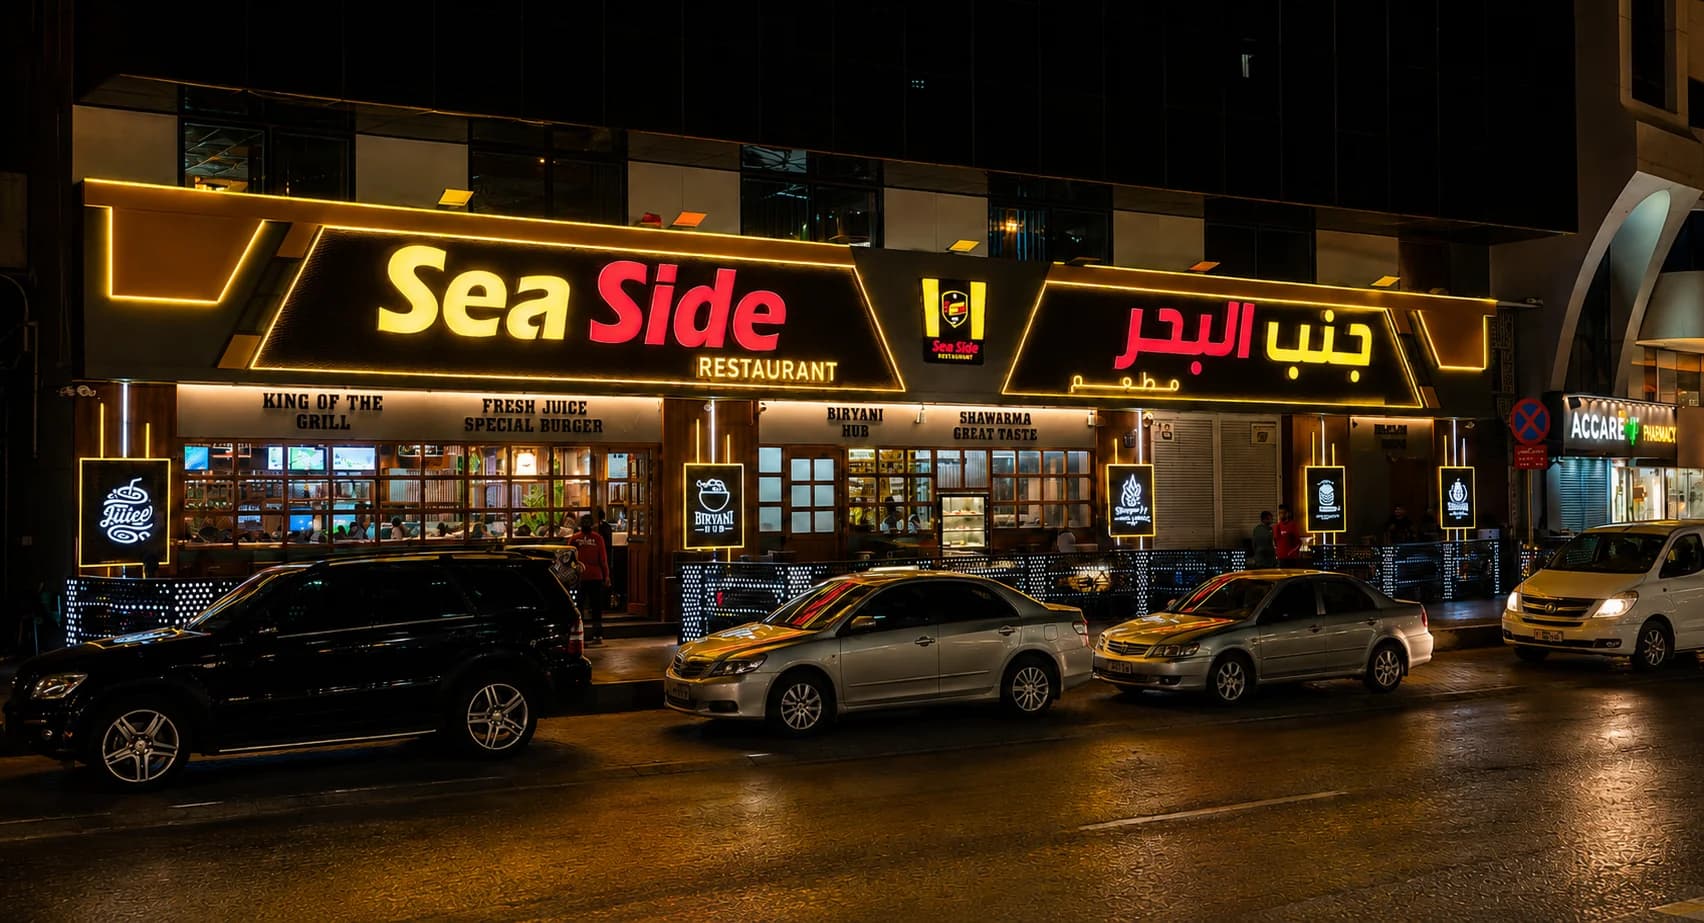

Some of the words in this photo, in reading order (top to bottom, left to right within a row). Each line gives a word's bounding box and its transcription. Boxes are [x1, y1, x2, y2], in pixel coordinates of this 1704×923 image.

[377, 245, 570, 341] Sea
[589, 260, 787, 351] Side
[1114, 301, 1255, 375] البحر
[1266, 309, 1373, 383] جنب
[698, 357, 838, 382] RESTAURANT
[1070, 372, 1180, 393] مطعم
[262, 393, 309, 410] KING
[317, 394, 340, 410] OF
[346, 395, 383, 411] THE
[482, 398, 536, 414] FRESH
[542, 400, 587, 415] JUICE
[296, 414, 350, 430] GRILL
[827, 407, 883, 422] BIRYANI
[959, 411, 1032, 425] SHAWARMA
[464, 417, 534, 432] SPECIAL
[540, 418, 603, 433] BURGER
[842, 424, 869, 438] HUB
[1571, 411, 1625, 440] ACCARE
[1643, 424, 1677, 444] PHARMACY
[953, 427, 995, 440] GREAT
[998, 428, 1038, 441] TASTE
[694, 511, 734, 525] BIRYANI
